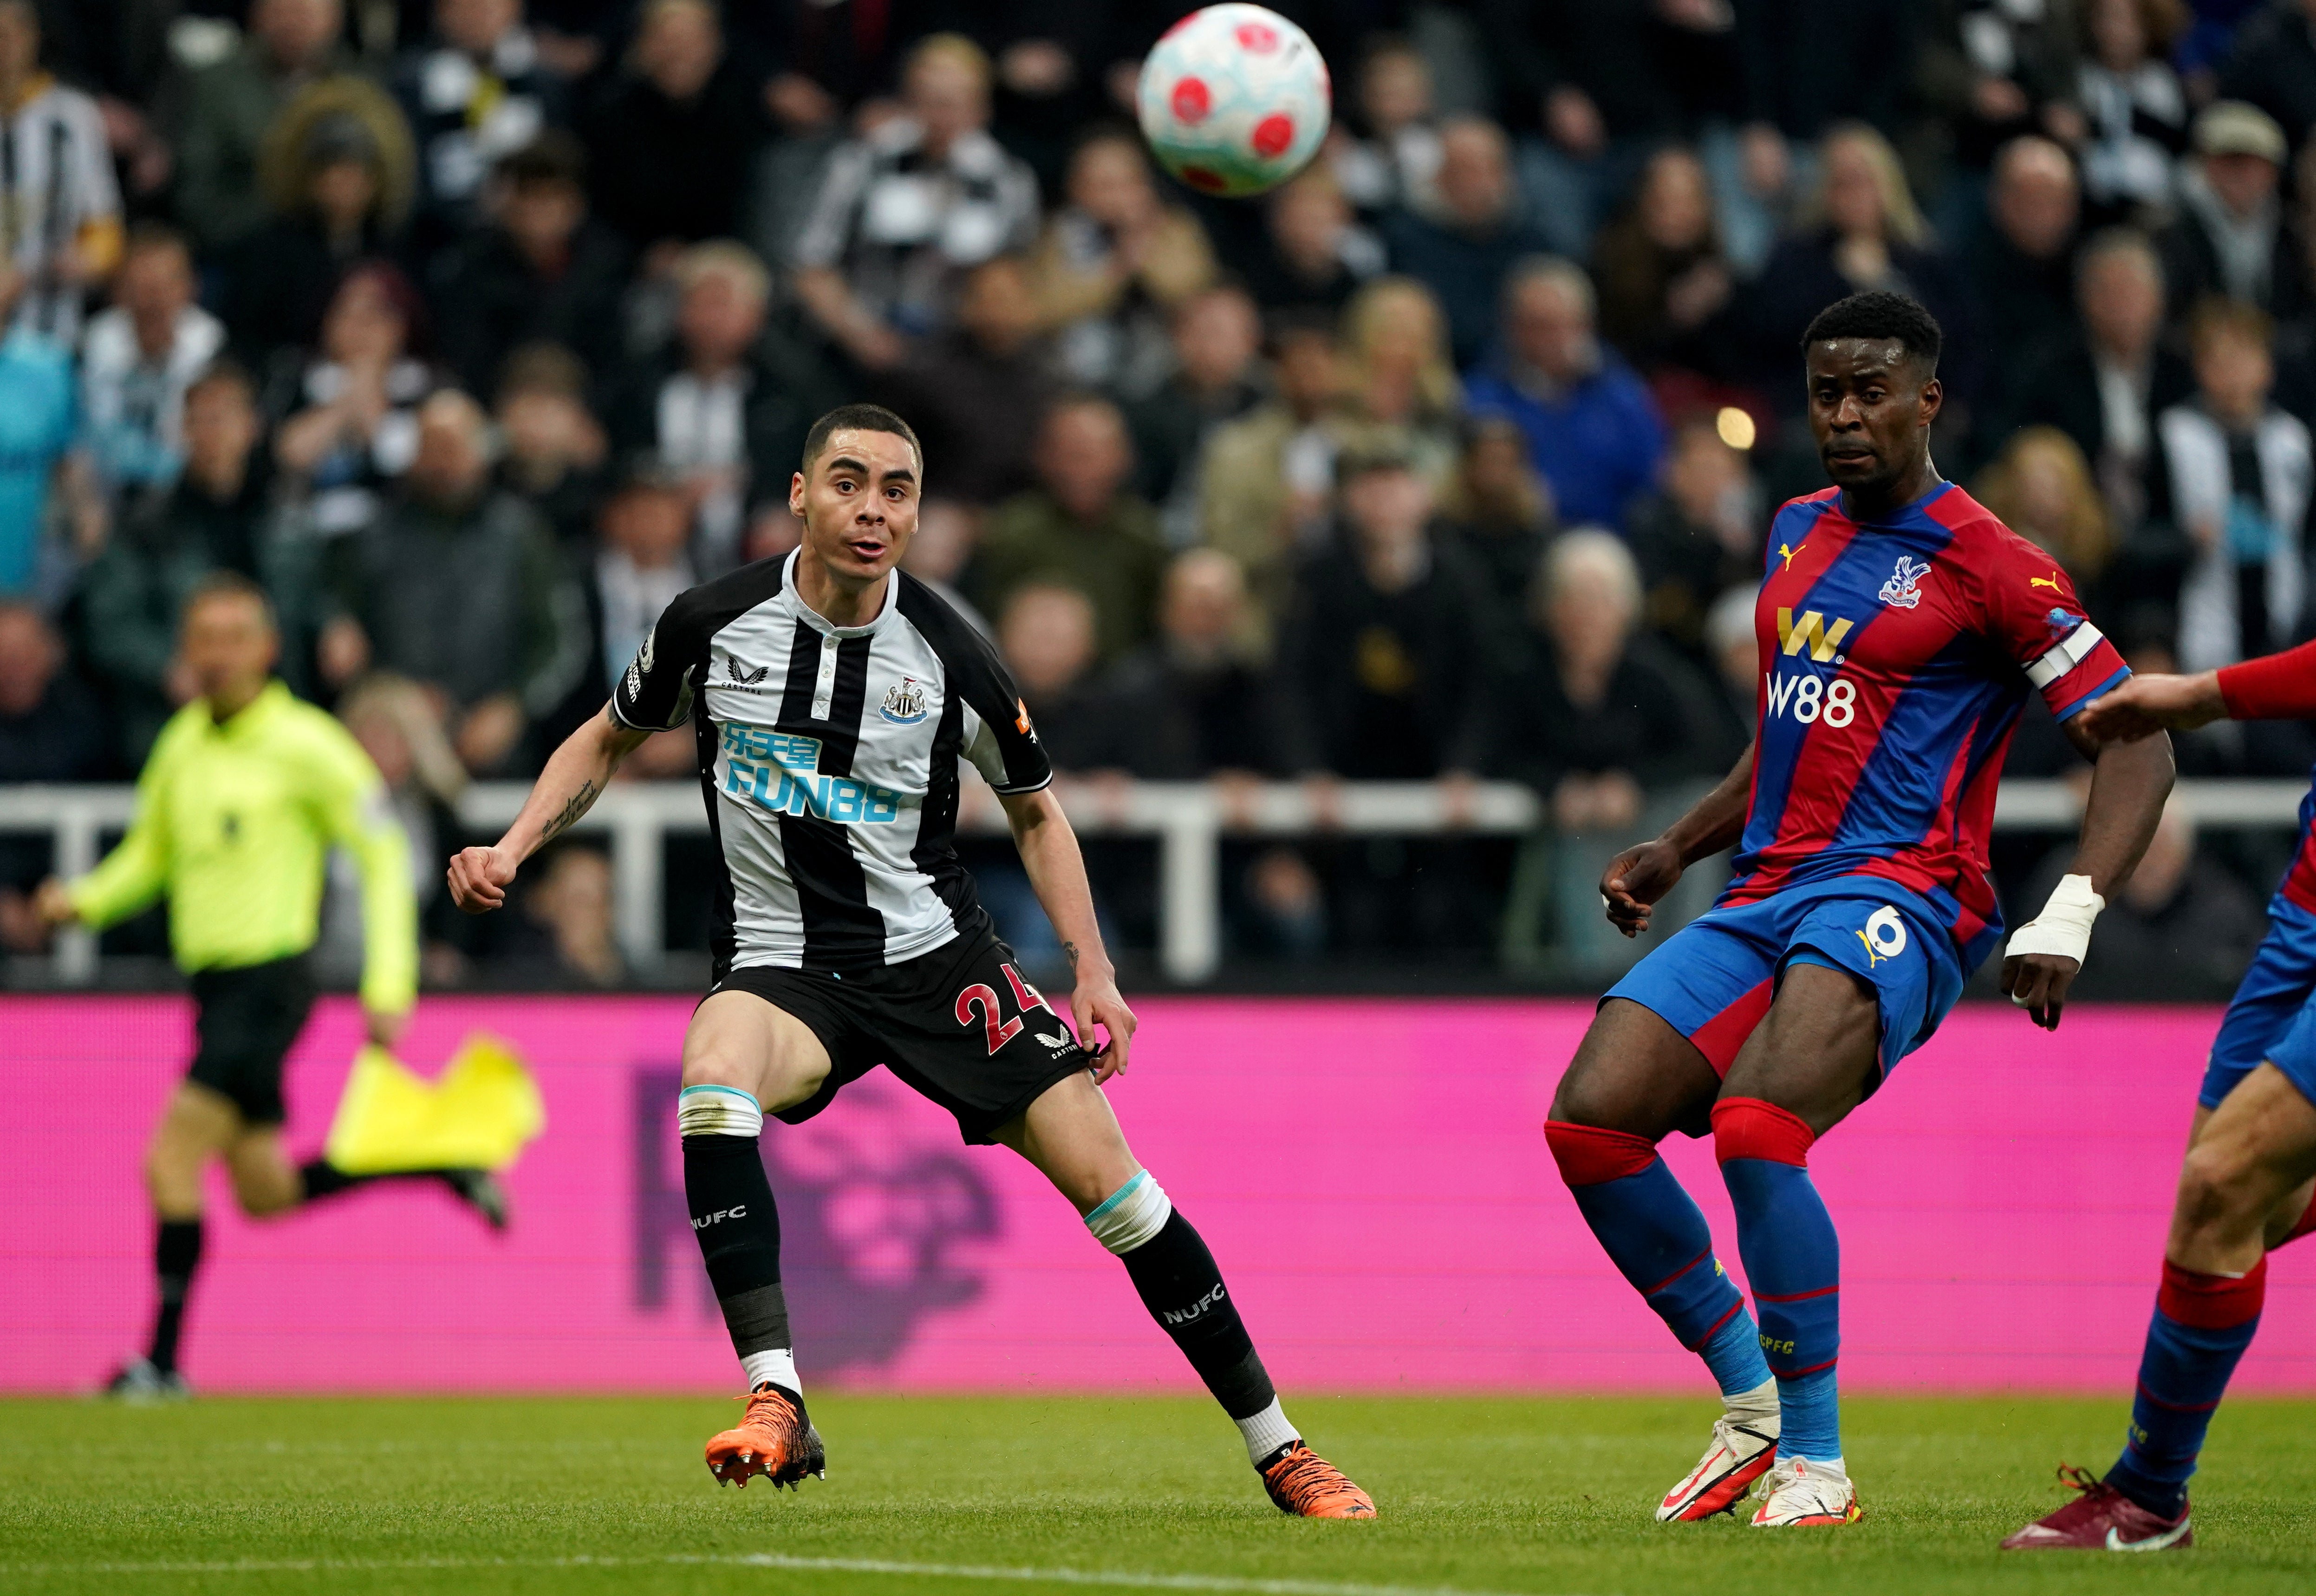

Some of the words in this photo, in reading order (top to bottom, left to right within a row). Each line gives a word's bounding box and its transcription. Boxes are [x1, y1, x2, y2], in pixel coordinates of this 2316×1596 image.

[722, 682, 761, 695] CASTORE
[1766, 671, 1856, 728] W88
[723, 723, 820, 770] 乐天堂
[725, 759, 903, 823] FUN88
[1866, 905, 1906, 957] 6
[955, 963, 1057, 1056] 24
[1163, 1283, 1225, 1324] NUFC
[1760, 1334, 1795, 1354] CPFC
